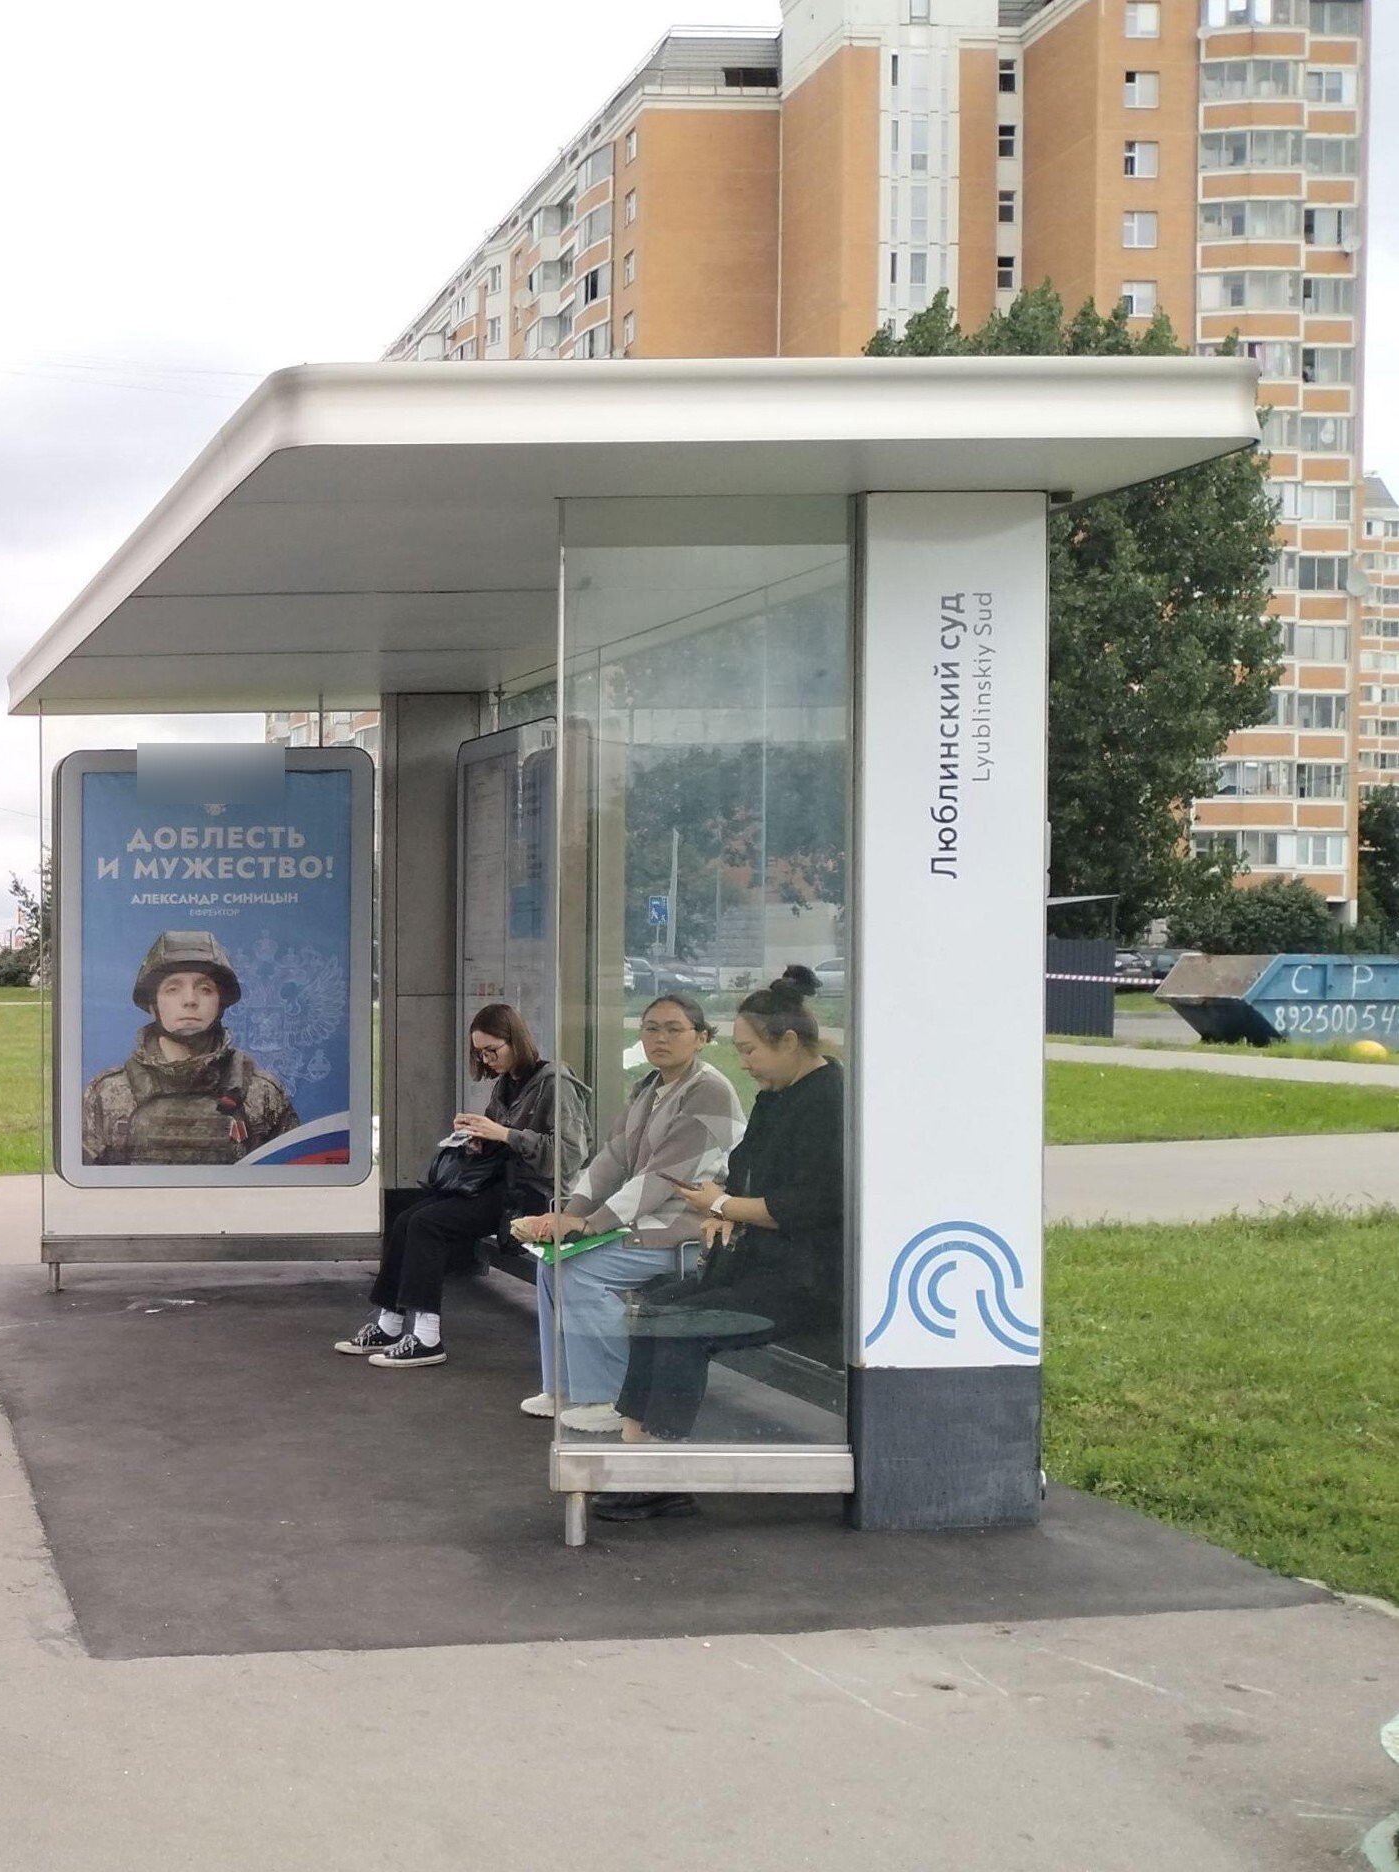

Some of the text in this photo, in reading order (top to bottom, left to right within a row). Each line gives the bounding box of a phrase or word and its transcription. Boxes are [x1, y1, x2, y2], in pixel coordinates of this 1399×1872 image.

[972, 592, 996, 782] Lyublinskiy Sud
[930, 592, 967, 879] Люблинский суд
[127, 826, 306, 852] ДОБЛЕСТЬ
[98, 856, 334, 879] И МУЖЕСТВО!
[131, 892, 299, 906] АЛЕКСАНДР СИНИЦЫН
[1274, 1004, 1399, 1034] 89250054
